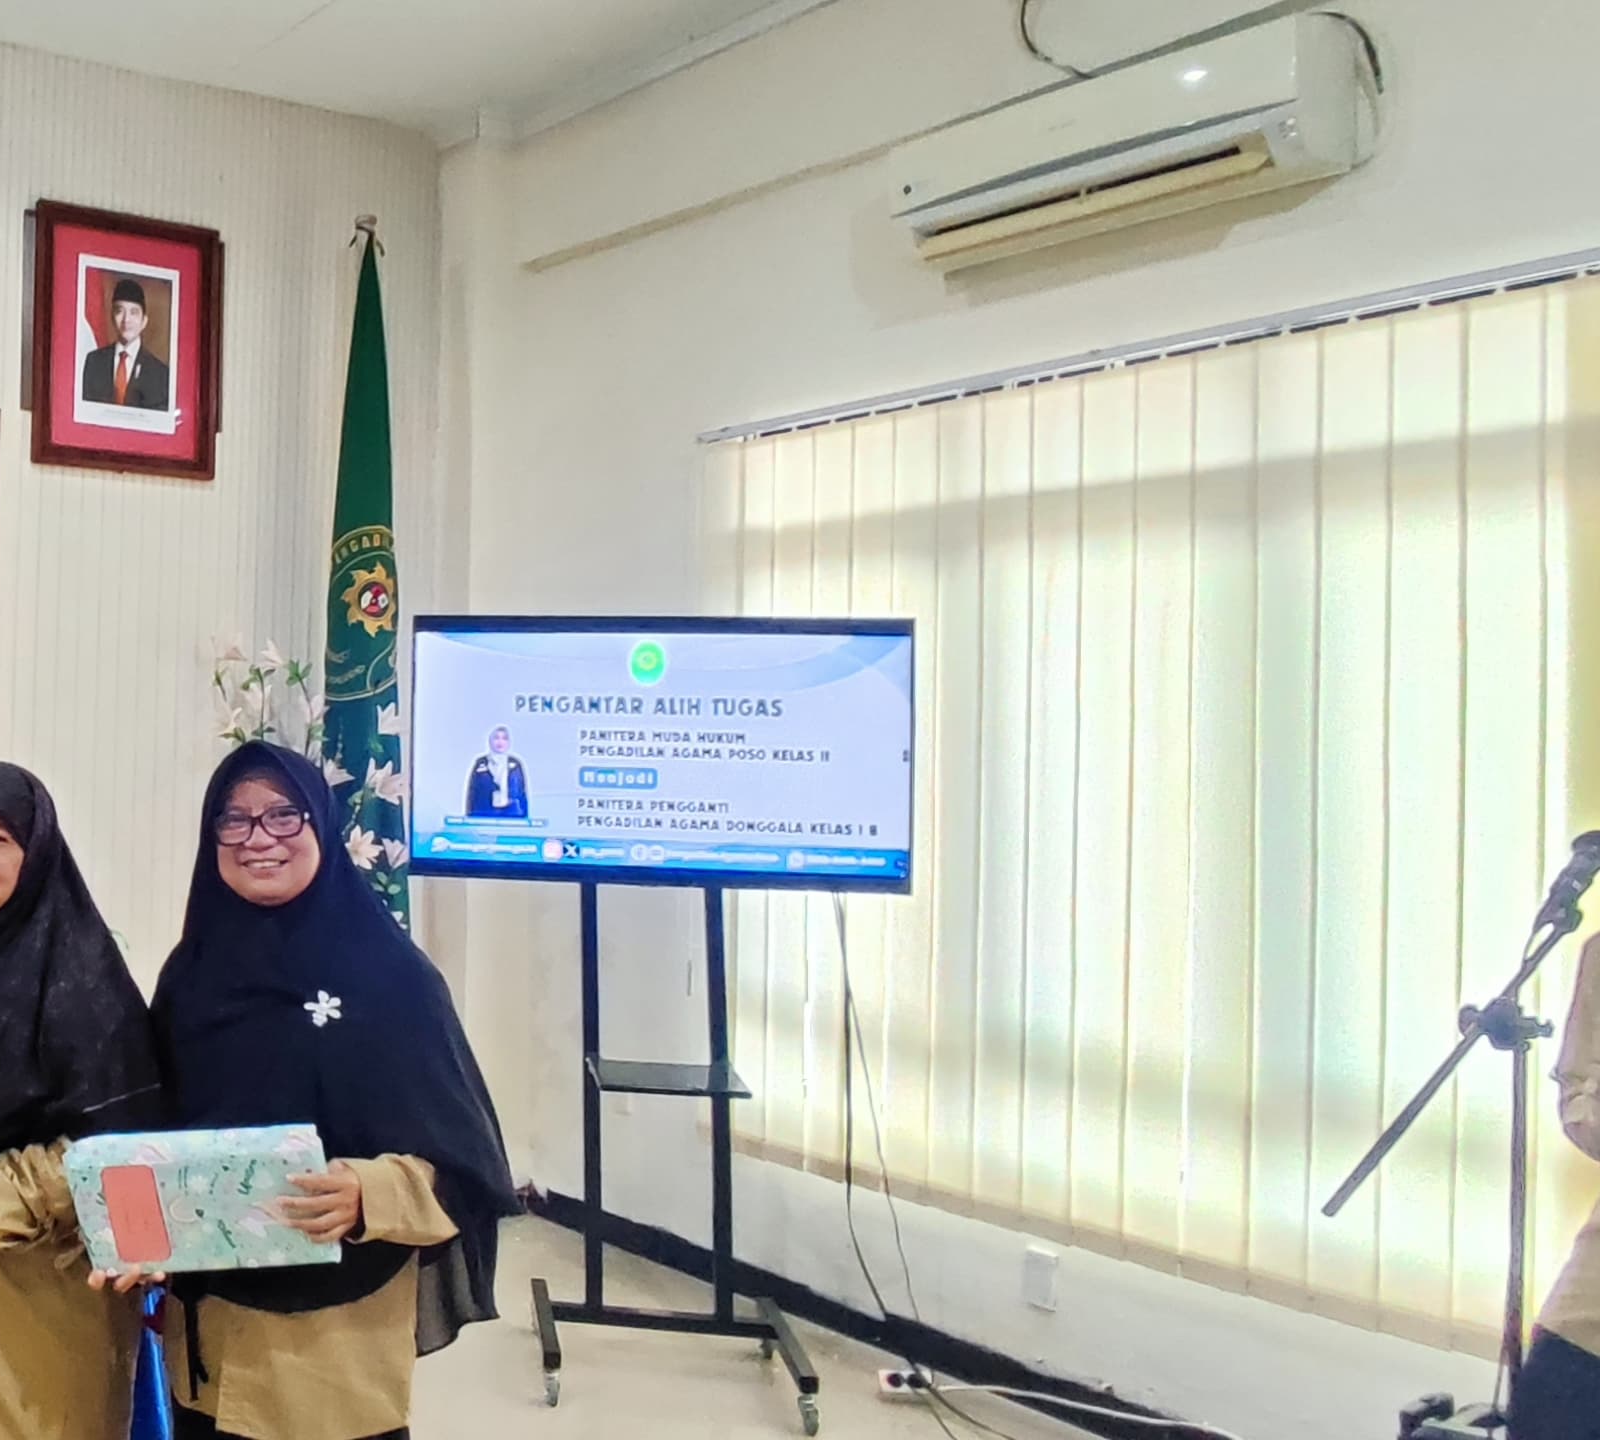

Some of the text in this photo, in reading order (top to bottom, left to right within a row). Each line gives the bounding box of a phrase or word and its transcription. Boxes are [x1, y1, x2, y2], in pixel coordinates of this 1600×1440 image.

[515, 694, 784, 717] PENGANTAR ALIH TUGAS
[580, 730, 746, 744] PANITERA MUDA HUKUM
[580, 745, 665, 758] PENGADILAN
[671, 747, 722, 759] AGAMA
[728, 748, 767, 761] POSO
[772, 750, 815, 762] KELAS
[577, 798, 729, 814] PANITERA PENGGANTI
[577, 815, 663, 829] PENGADILAN
[669, 818, 720, 830] AGAMA
[726, 820, 804, 834] DONGGALA
[809, 823, 853, 836] KELAS
